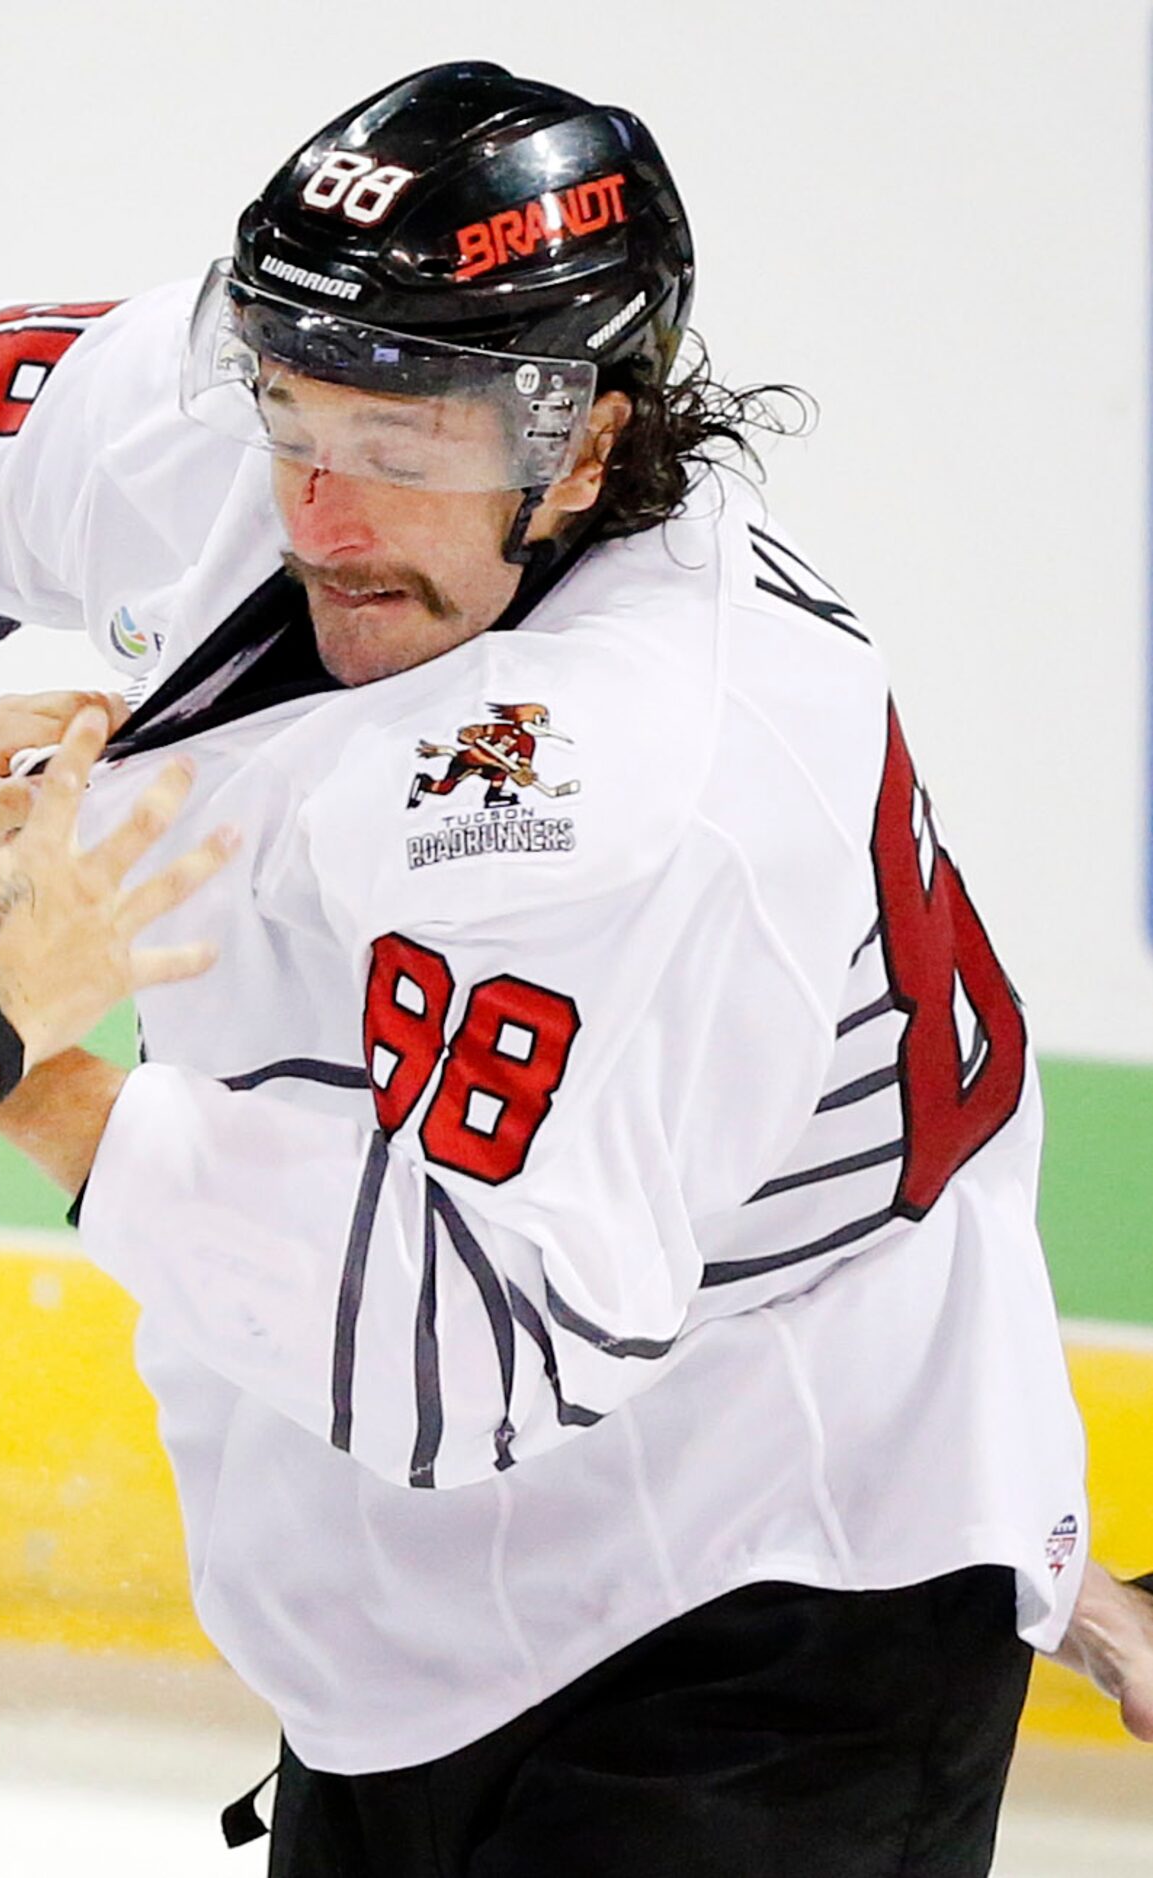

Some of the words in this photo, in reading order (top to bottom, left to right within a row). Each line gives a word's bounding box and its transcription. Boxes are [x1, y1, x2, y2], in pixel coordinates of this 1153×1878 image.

[302, 150, 415, 226] 88
[454, 172, 626, 282] BRANDT
[260, 254, 363, 301] WARRIOR
[407, 818, 576, 870] ROADRUNNERS
[442, 807, 535, 827] TUCSON
[362, 931, 581, 1187] 88
